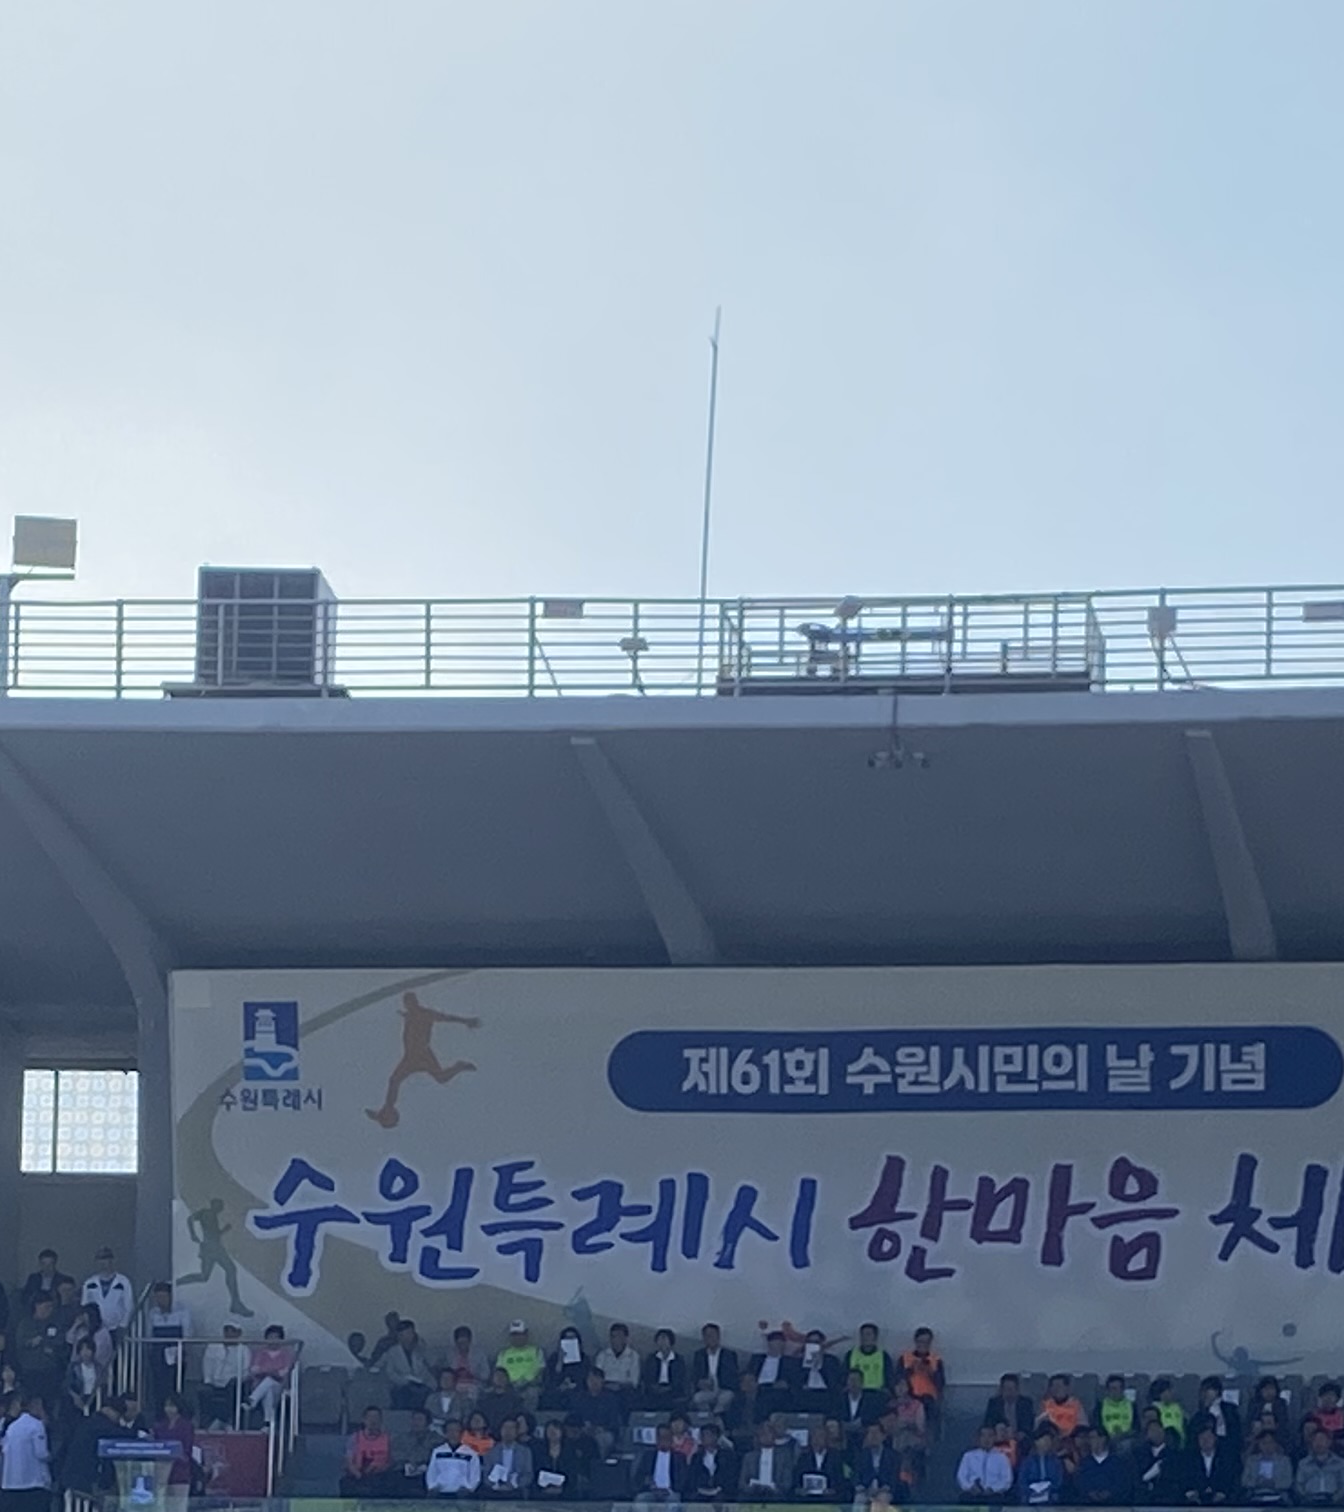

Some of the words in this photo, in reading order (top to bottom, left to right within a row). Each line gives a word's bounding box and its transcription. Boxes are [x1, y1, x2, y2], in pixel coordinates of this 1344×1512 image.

[682, 1046, 830, 1097] 제61회
[845, 1043, 1088, 1095] 수원시민의
[1106, 1042, 1154, 1093] 날
[1168, 1041, 1266, 1093] 기념
[220, 1086, 324, 1112] 수원특례시
[253, 1157, 819, 1288] 수원특례시
[848, 1154, 1180, 1283] 한마음
